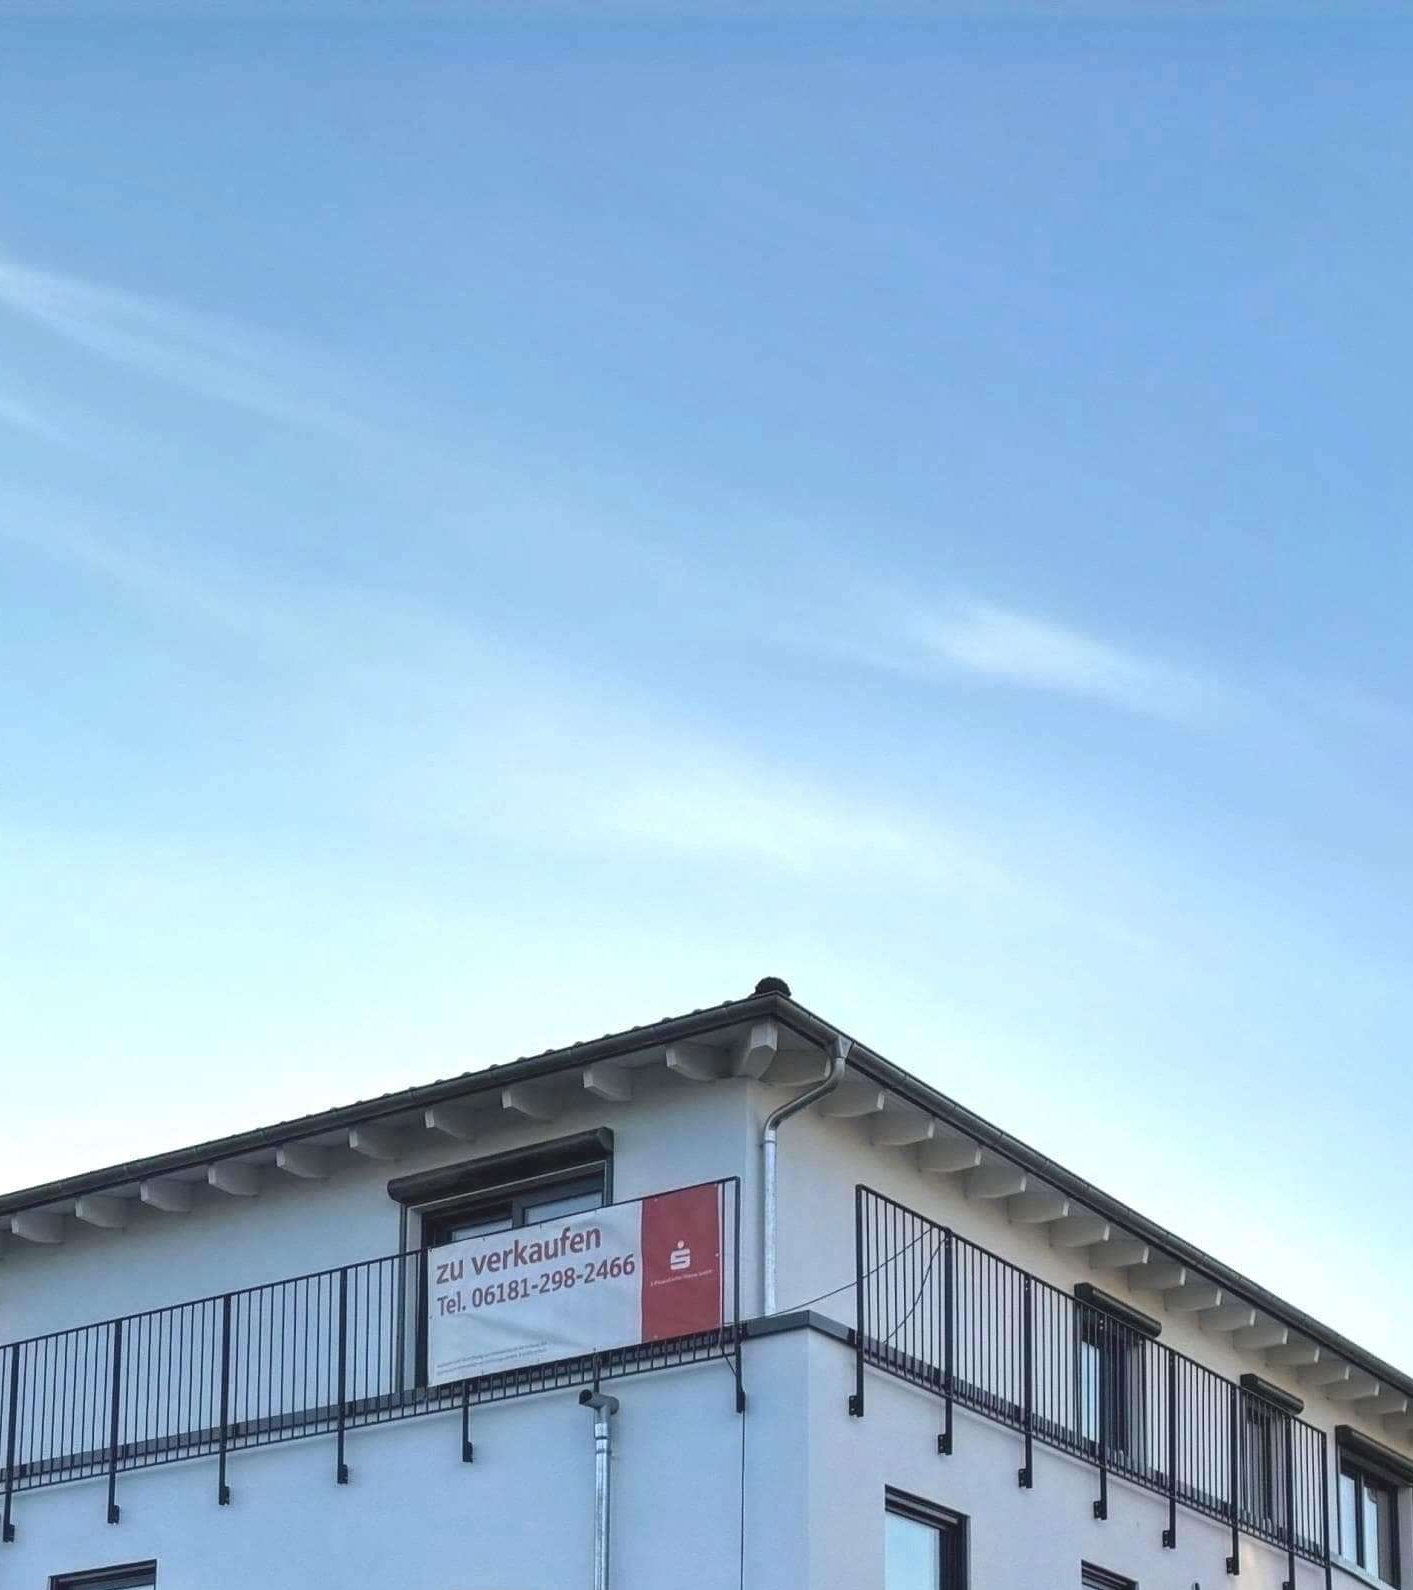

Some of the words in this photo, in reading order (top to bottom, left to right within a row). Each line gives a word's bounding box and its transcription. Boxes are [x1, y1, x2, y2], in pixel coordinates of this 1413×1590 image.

[436, 1259, 464, 1285] zu
[472, 1226, 601, 1276] verkaufen
[437, 1292, 467, 1316] Tel.
[472, 1253, 636, 1308] 06181-298-2466
